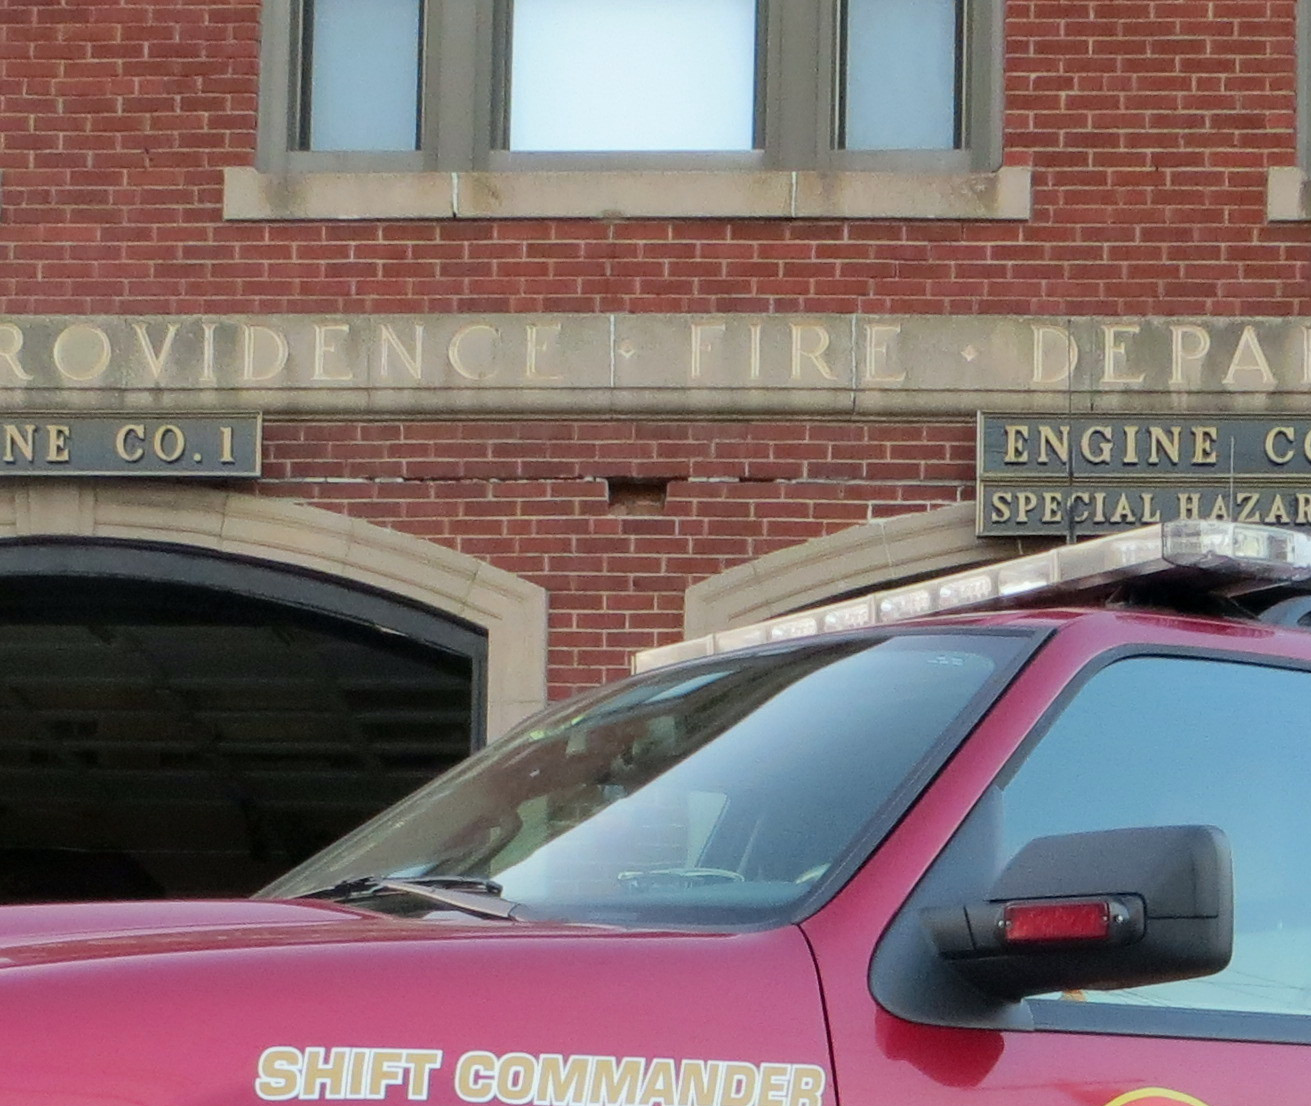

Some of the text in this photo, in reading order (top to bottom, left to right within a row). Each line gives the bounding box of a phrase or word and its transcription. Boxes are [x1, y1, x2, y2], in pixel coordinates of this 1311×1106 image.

[690, 323, 908, 383] FIRE
[1002, 425, 1218, 465] ENGINE
[990, 492, 1161, 524] SPECIAL
[255, 1046, 444, 1101] SHIFT
